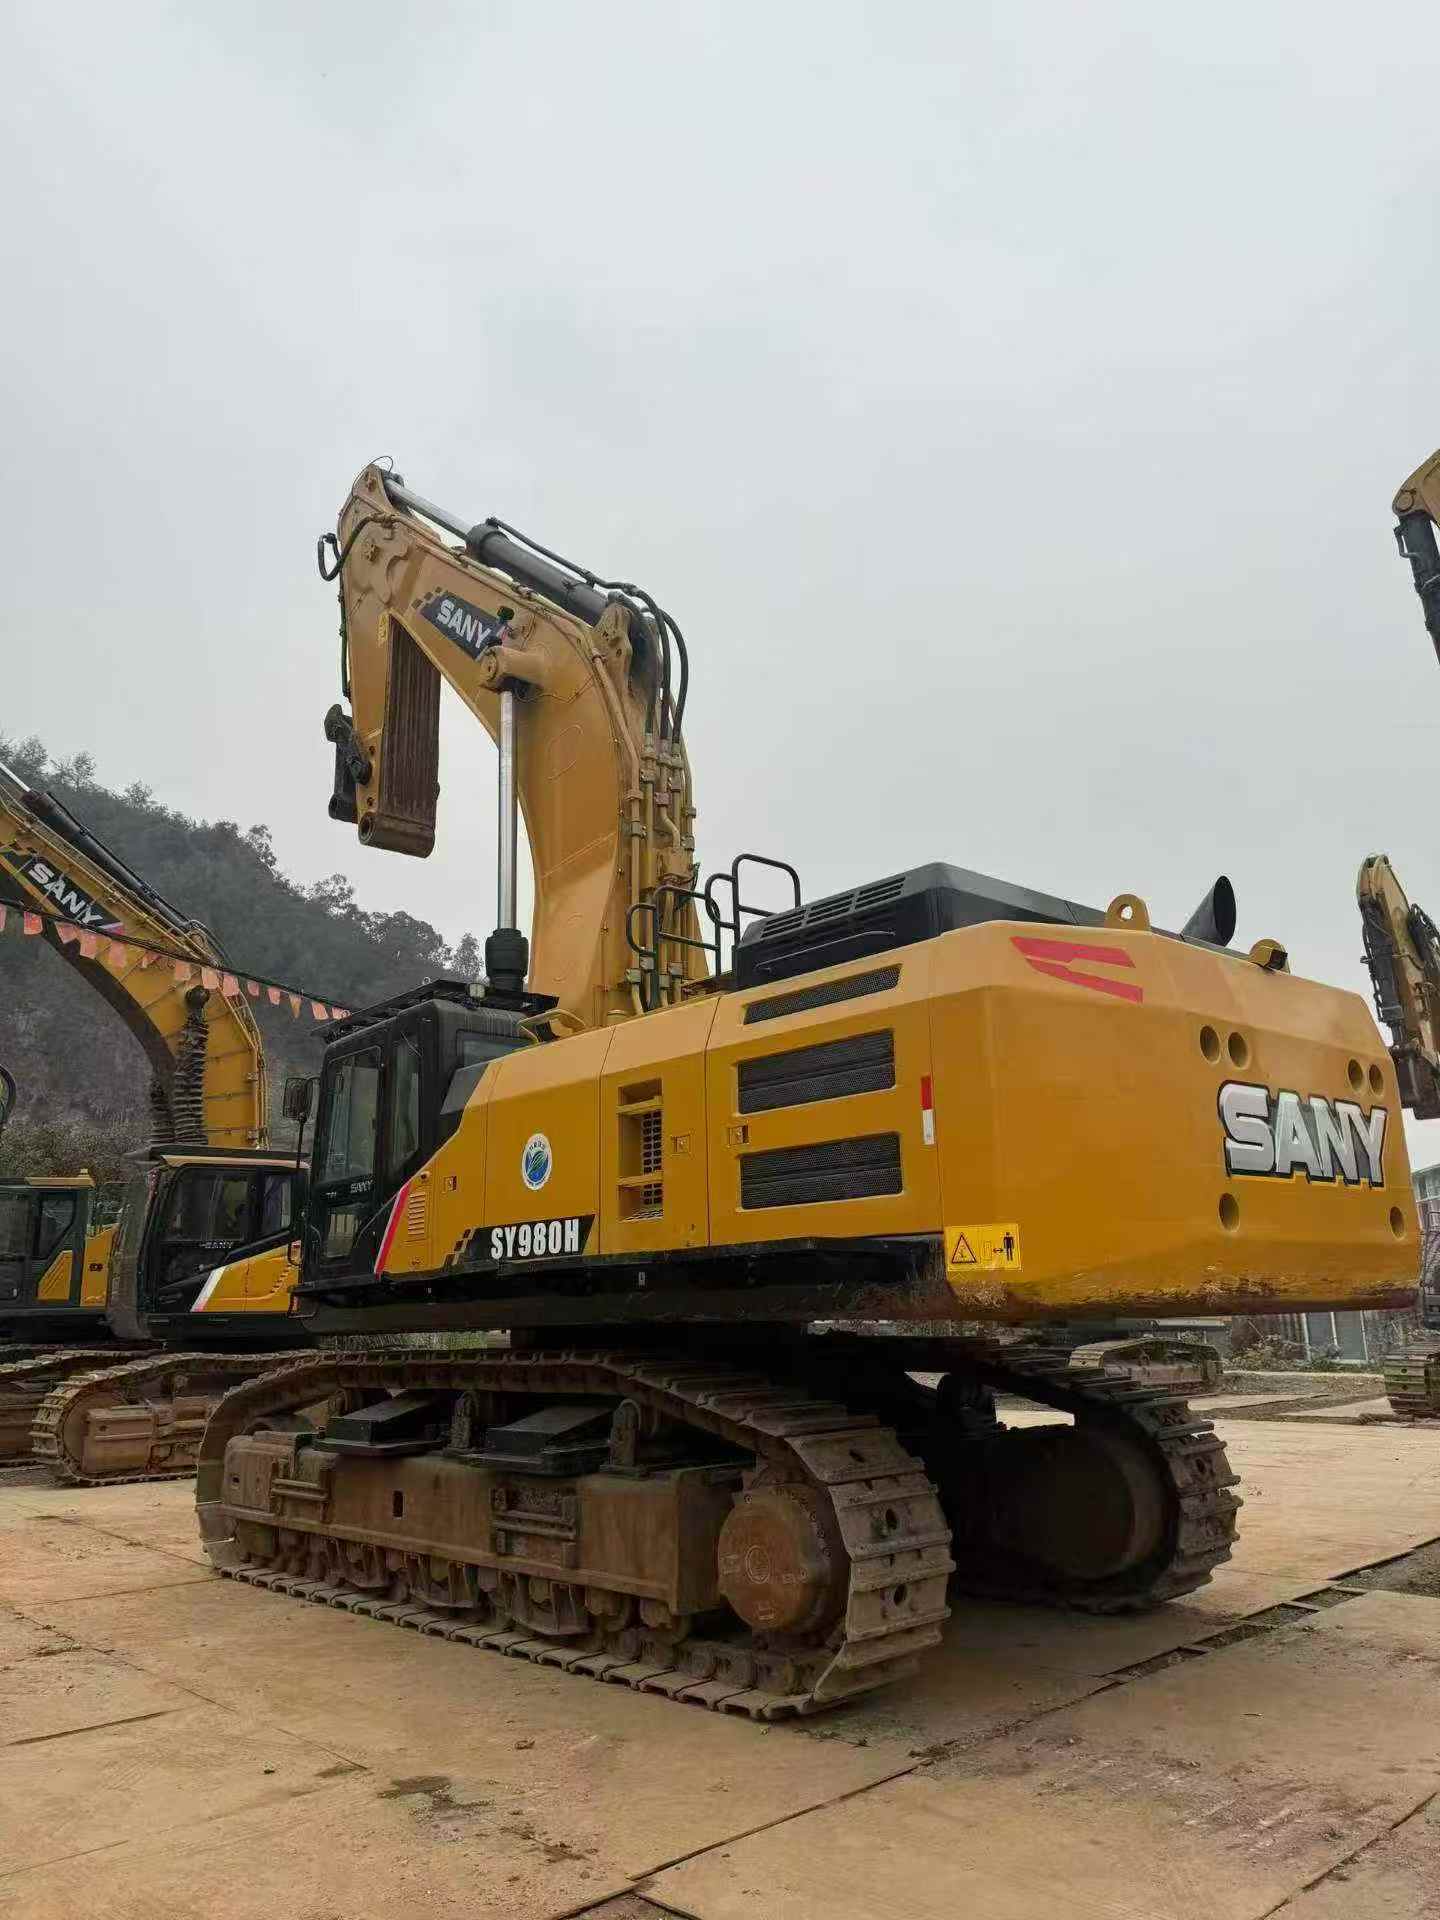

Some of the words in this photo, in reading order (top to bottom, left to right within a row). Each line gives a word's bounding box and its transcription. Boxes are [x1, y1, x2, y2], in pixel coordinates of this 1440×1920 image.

[437, 599, 492, 649] SANY
[28, 862, 103, 924] SANY
[1218, 1080, 1388, 1188] SANY
[490, 1218, 580, 1260] SY980H
